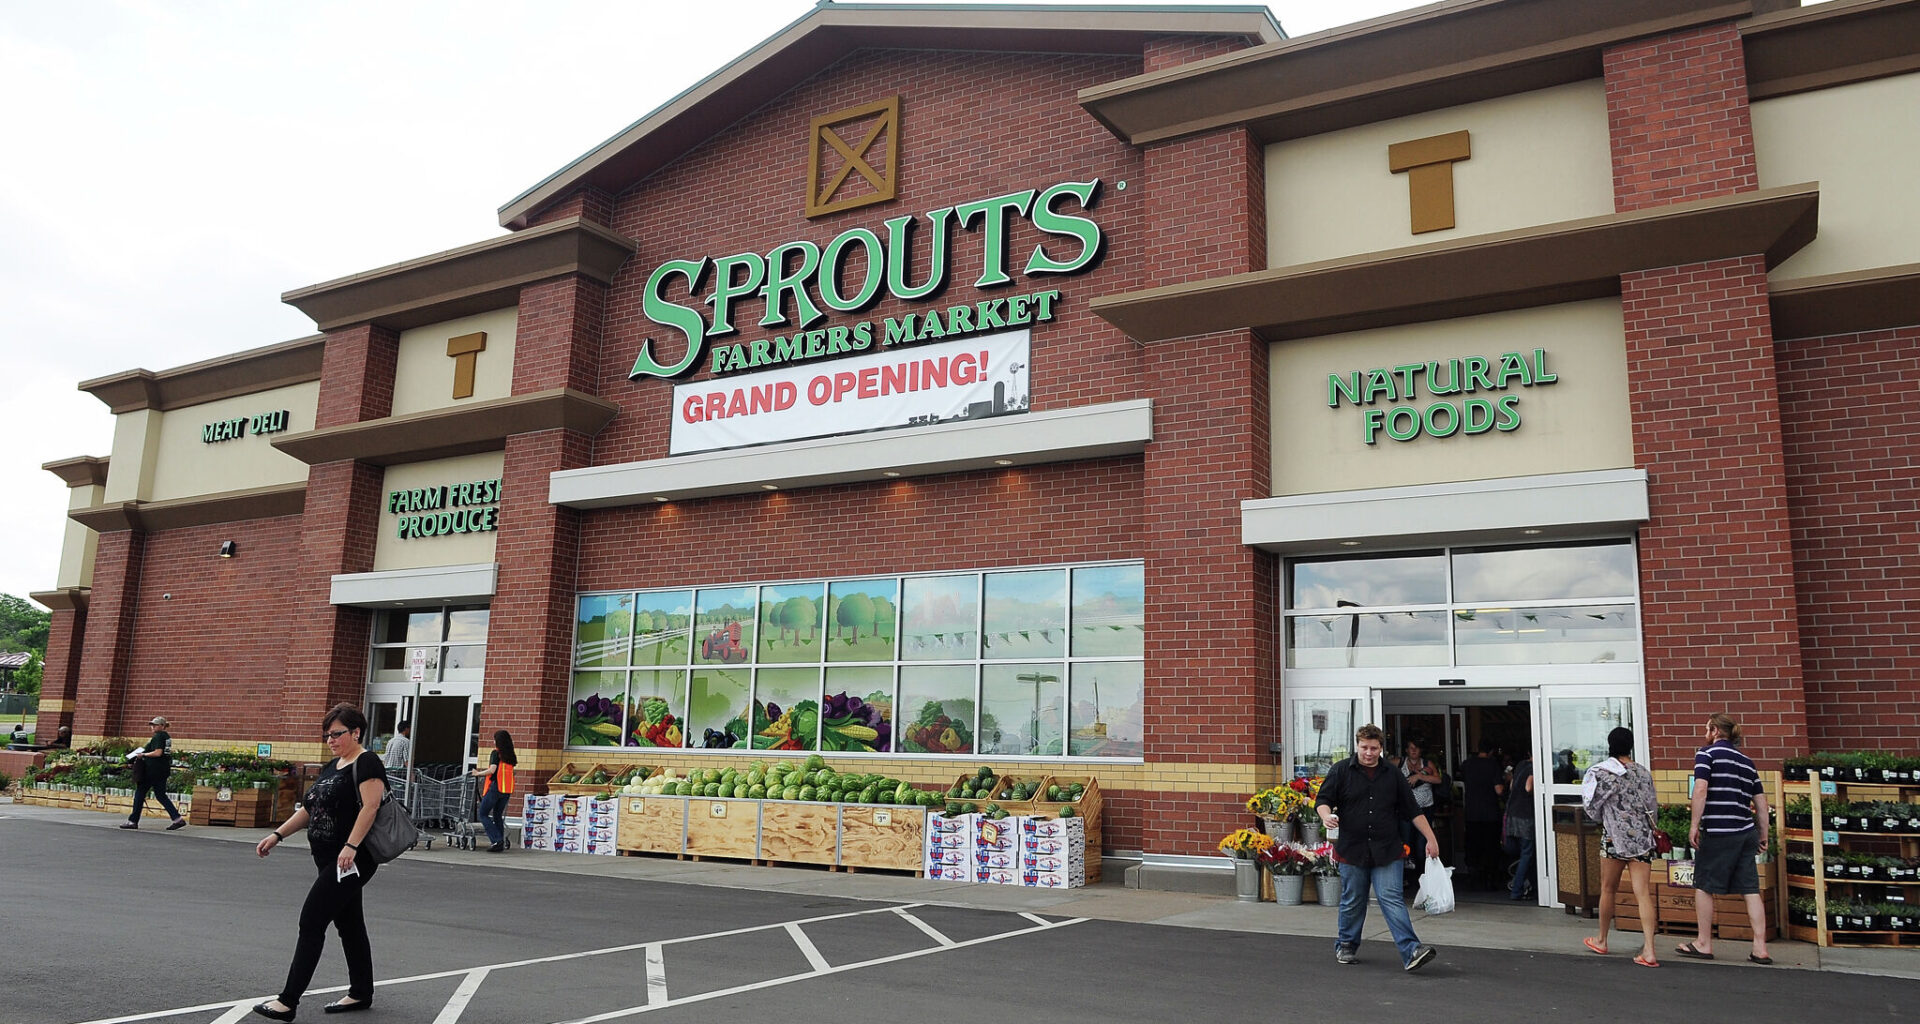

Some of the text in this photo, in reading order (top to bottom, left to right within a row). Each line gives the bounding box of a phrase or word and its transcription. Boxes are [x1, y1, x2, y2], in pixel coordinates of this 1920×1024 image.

[628, 177, 1104, 380] SPROUTS
[711, 290, 1060, 373] FARMERS MARKET
[682, 350, 990, 424] GRAND OPENING!
[1327, 348, 1558, 407] NATURAL
[201, 409, 287, 443] MEAT DELI
[1363, 395, 1522, 443] FOODS
[388, 484, 445, 512] FARM
[397, 506, 496, 539] PRODUCE
